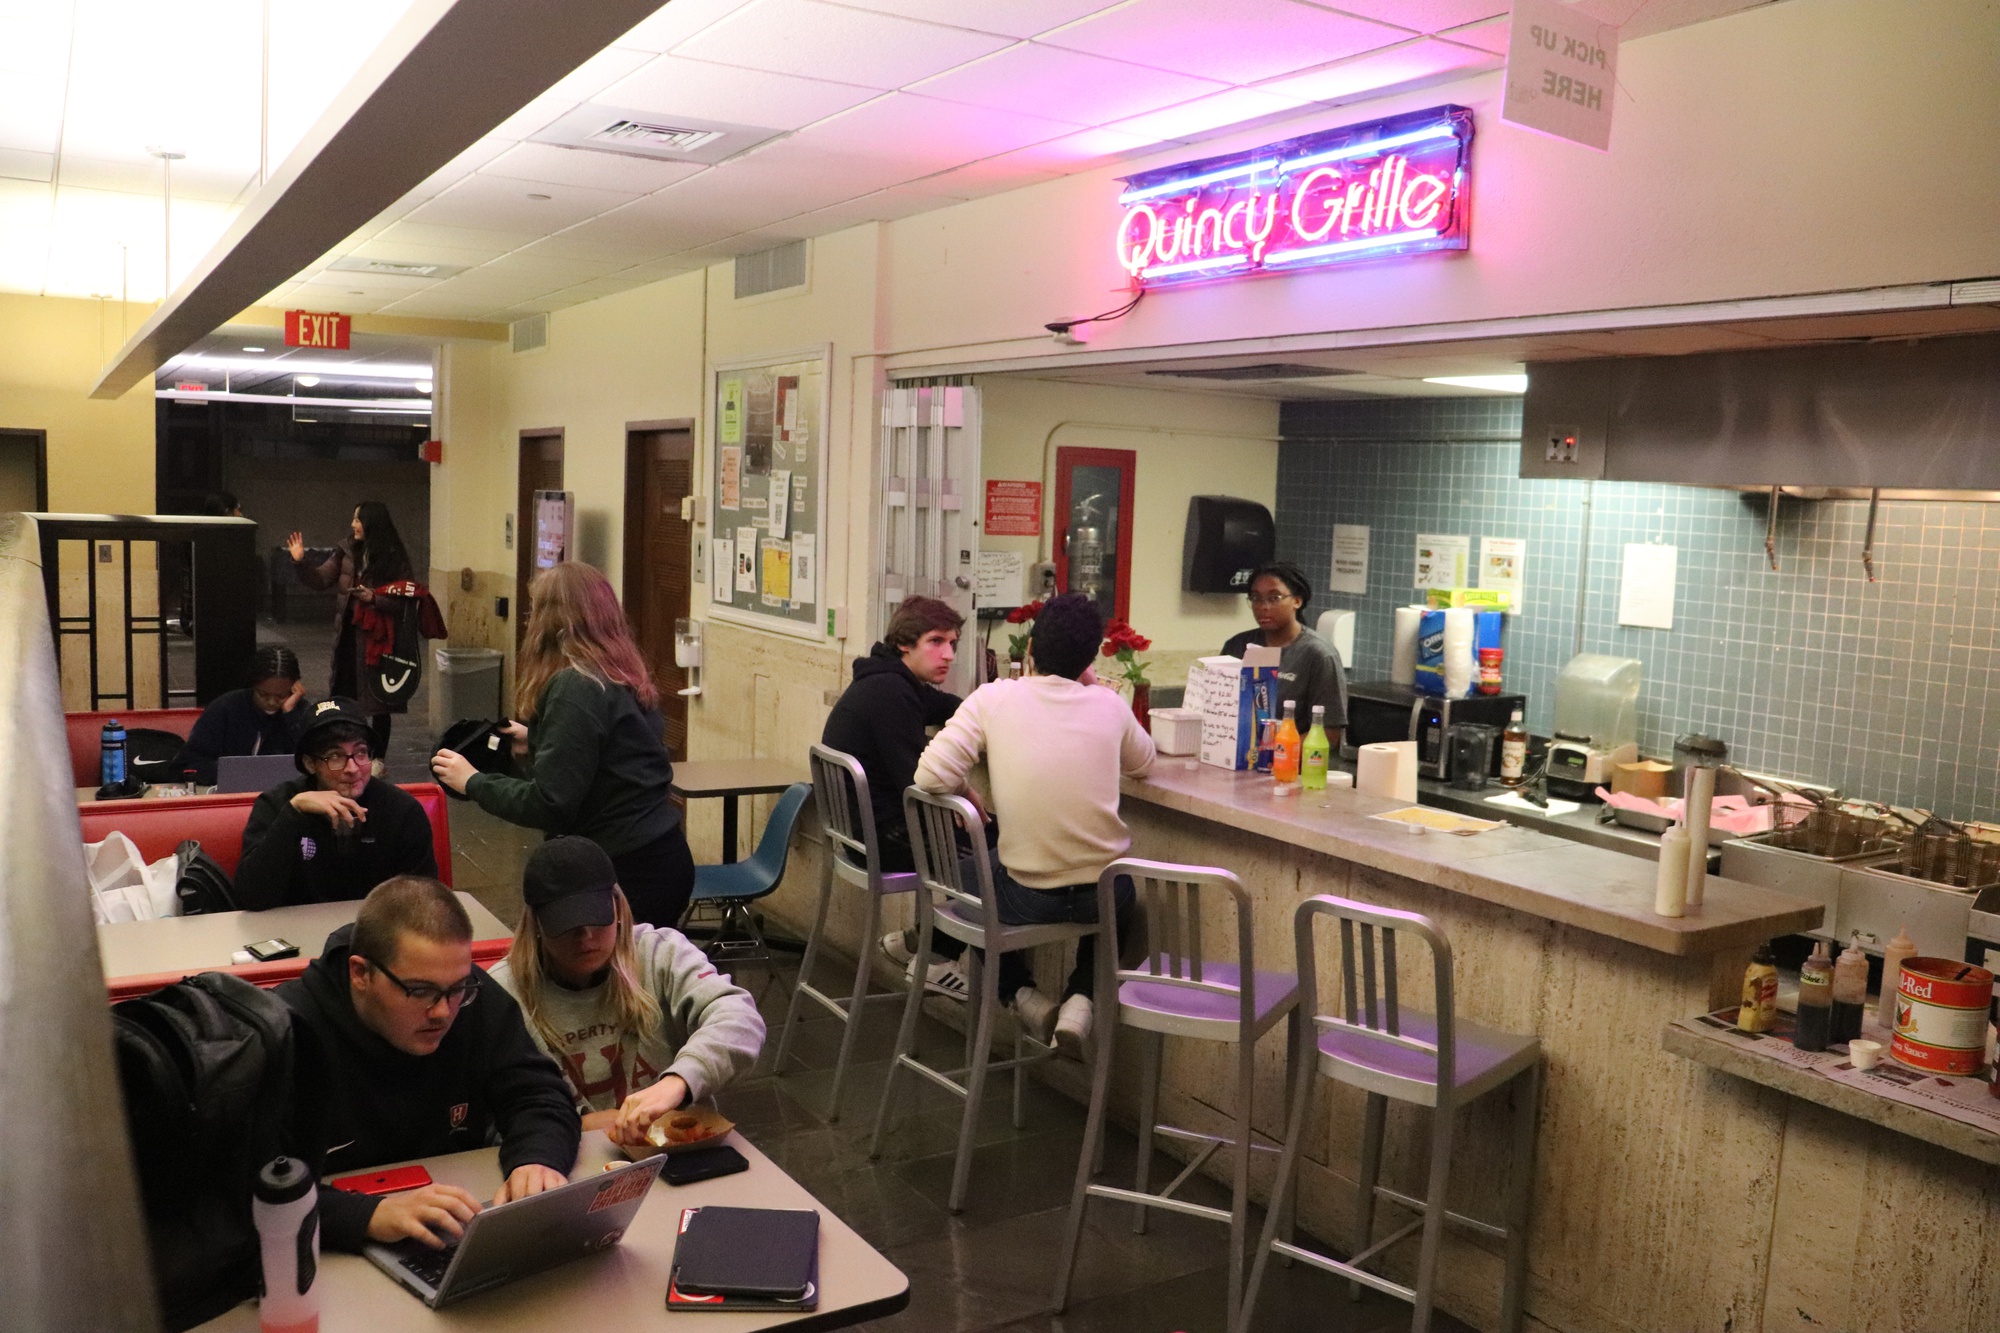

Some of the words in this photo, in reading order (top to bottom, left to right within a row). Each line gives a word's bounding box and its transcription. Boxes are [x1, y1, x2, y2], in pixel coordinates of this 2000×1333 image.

[1116, 190, 1279, 274] Quincy
[1289, 154, 1446, 242] Grille
[298, 314, 340, 348] EXIT
[564, 1023, 619, 1046] PERTY
[1903, 1043, 1929, 1060] Sauce
